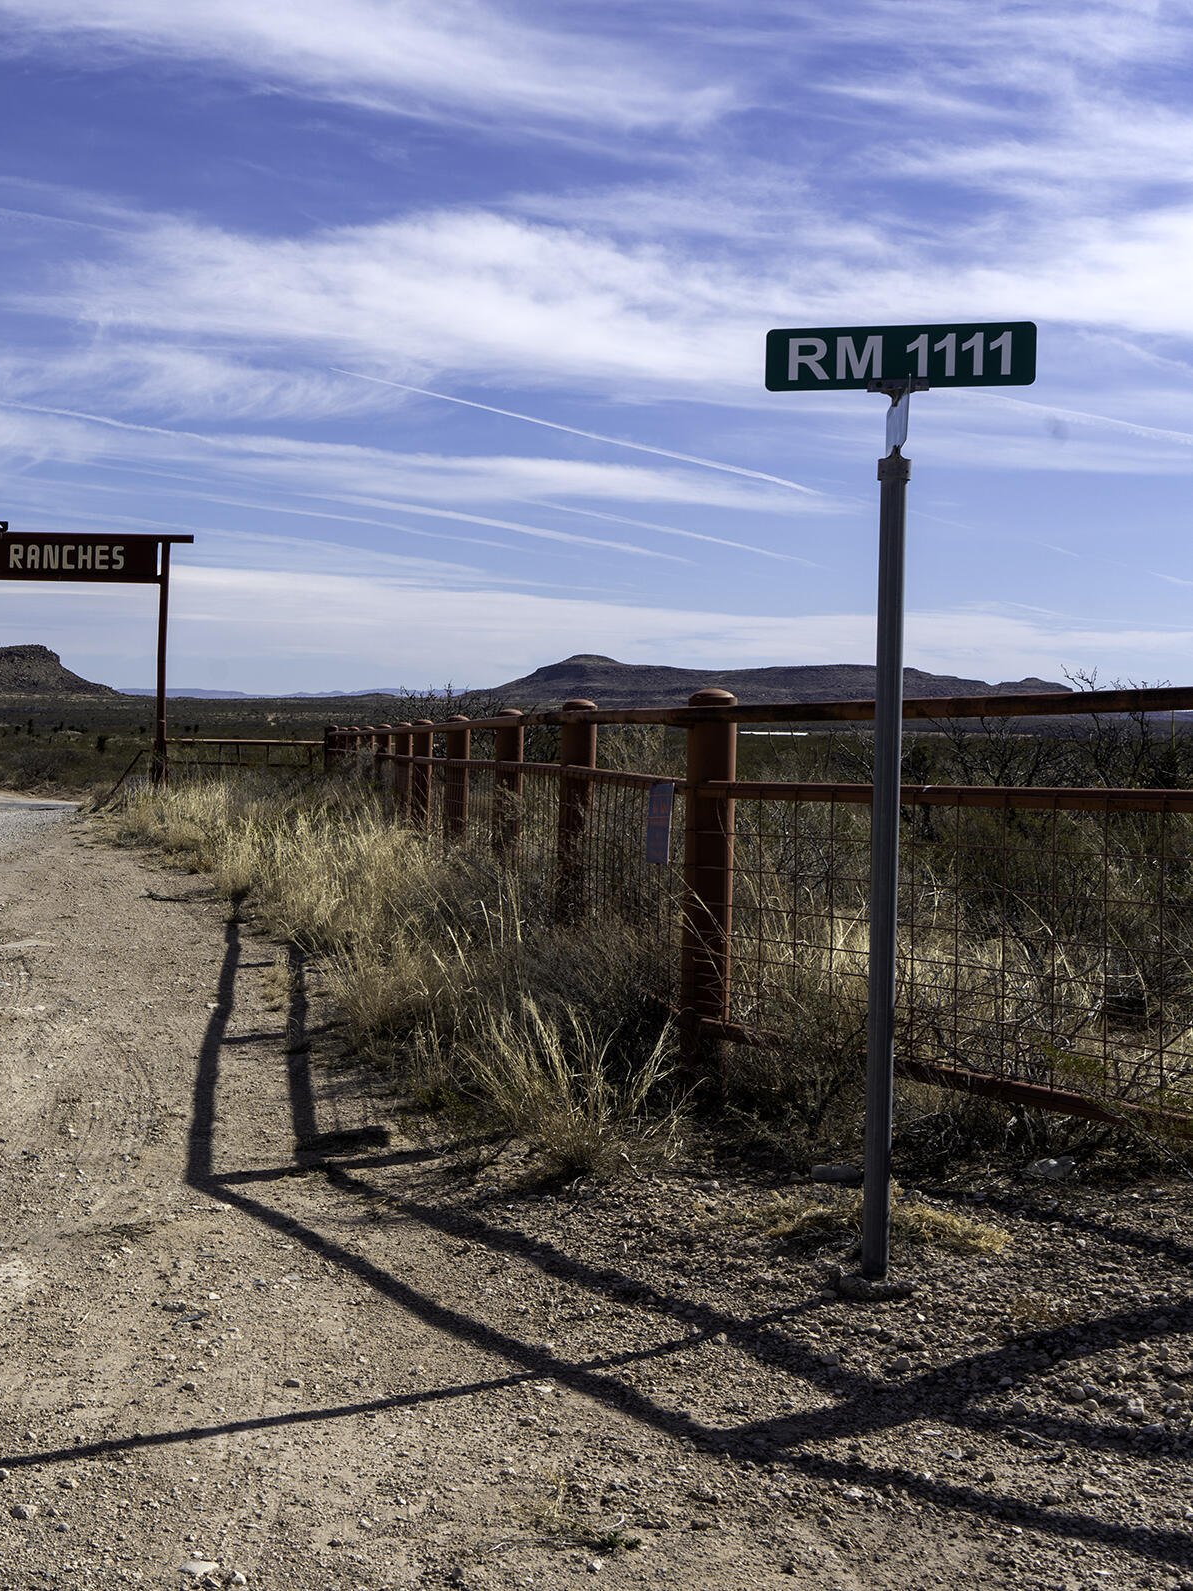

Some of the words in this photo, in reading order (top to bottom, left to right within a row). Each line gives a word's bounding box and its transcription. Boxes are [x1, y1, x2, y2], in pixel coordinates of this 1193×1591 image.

[787, 335, 883, 381] RM
[906, 331, 1013, 378] 1111
[9, 544, 125, 570] RANCHES
